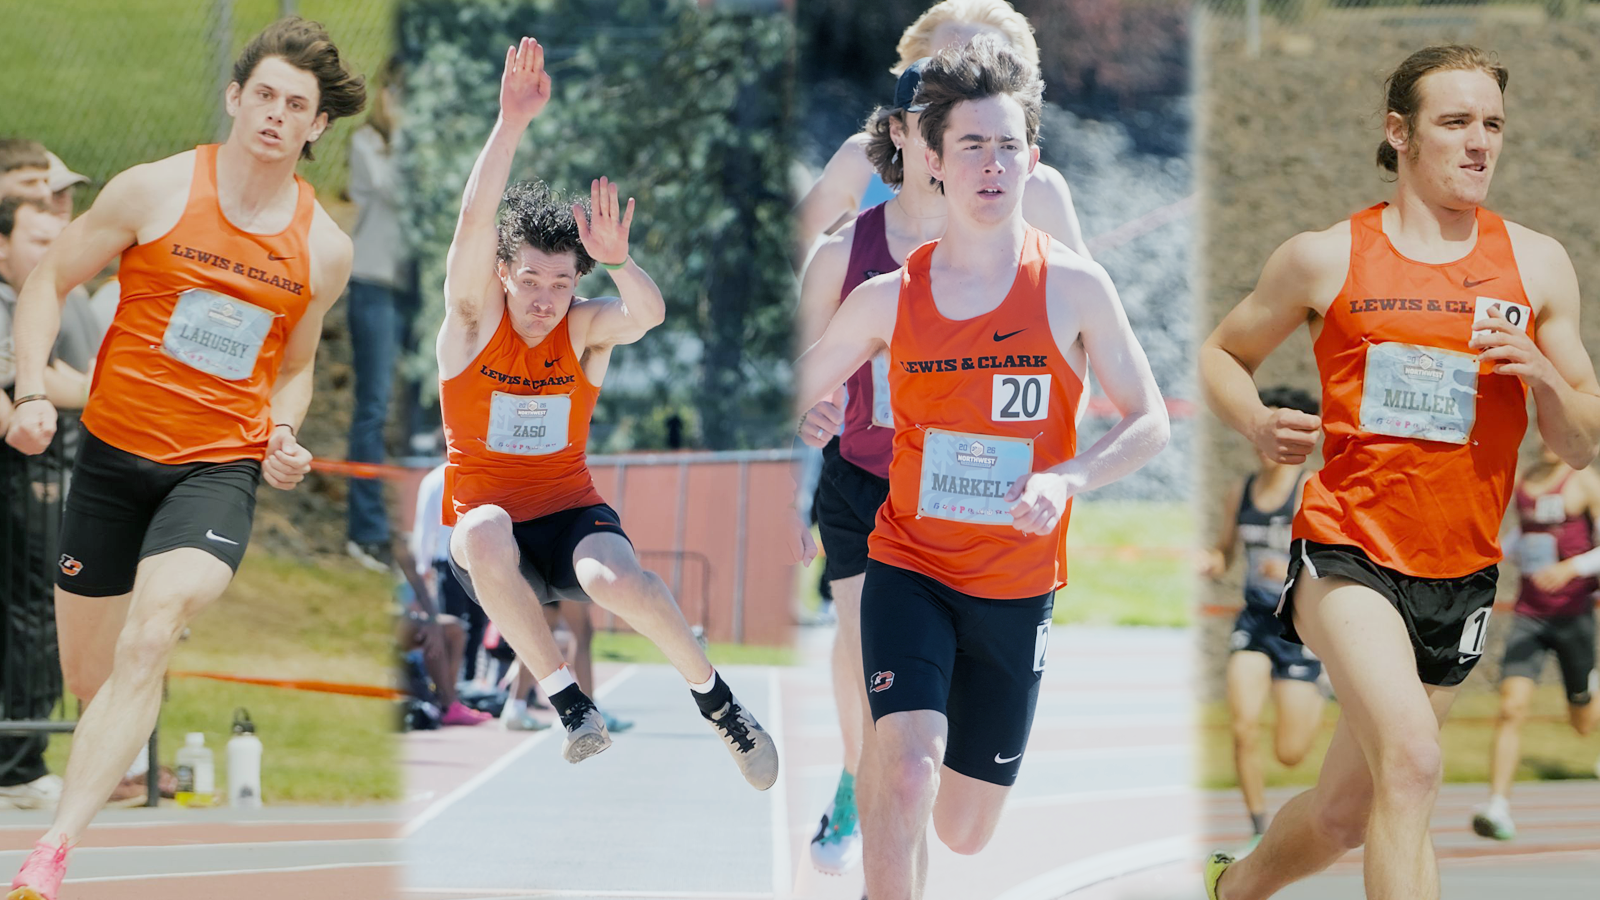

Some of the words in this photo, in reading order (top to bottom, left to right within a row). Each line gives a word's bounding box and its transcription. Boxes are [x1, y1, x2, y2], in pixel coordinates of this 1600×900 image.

[171, 244, 231, 271] LEWIS
[232, 262, 245, 276] &
[247, 267, 305, 296] CLARK
[1349, 298, 1422, 314] LEWIS
[1427, 299, 1442, 312] &
[1445, 300, 1475, 314] CL
[179, 324, 250, 359] LAHUSKY
[899, 358, 958, 373] LEWIS
[961, 357, 975, 370] &
[977, 355, 1048, 369] CLARK
[480, 365, 521, 385] LEWIS
[522, 378, 531, 387] &
[532, 375, 576, 390] CLARK
[999, 377, 1042, 419] 20
[1383, 388, 1458, 416] MILLER
[513, 425, 546, 438] ZASO
[958, 443, 968, 452] 20
[957, 454, 997, 466] NORTHWEST
